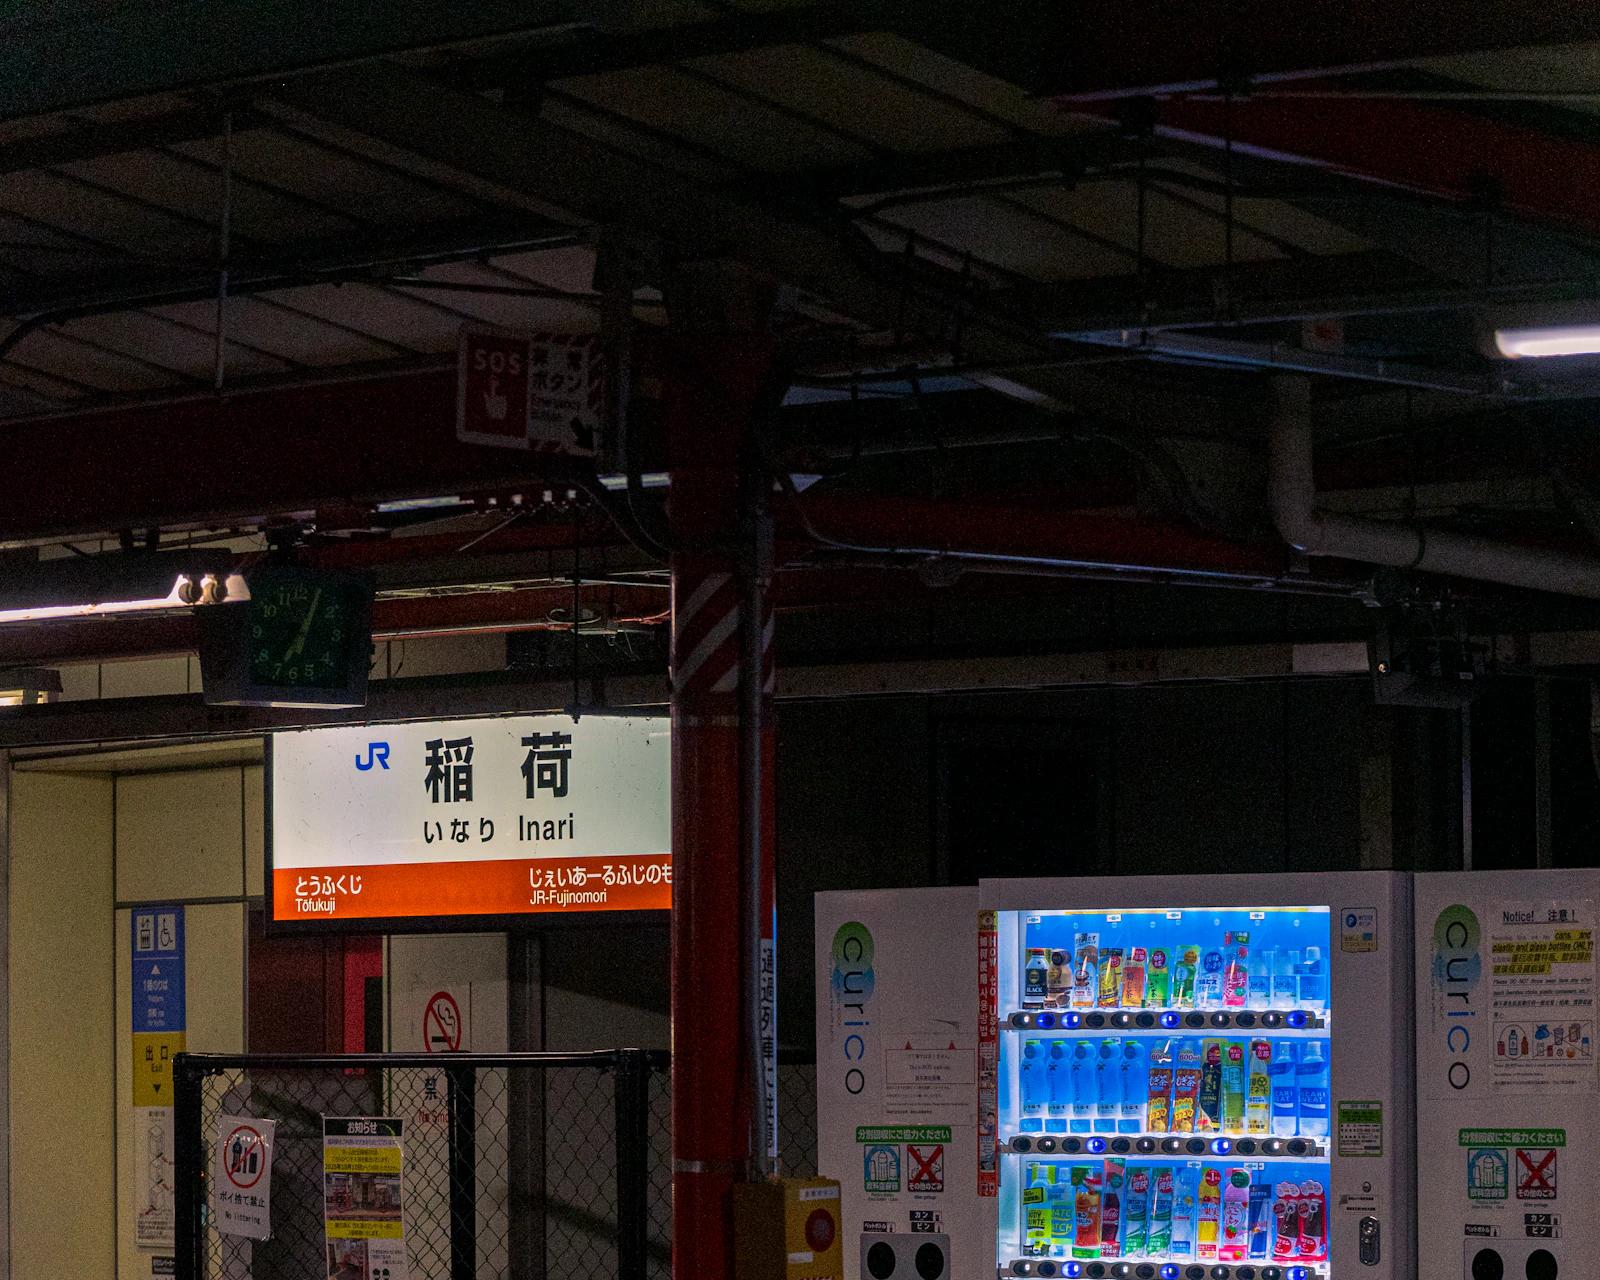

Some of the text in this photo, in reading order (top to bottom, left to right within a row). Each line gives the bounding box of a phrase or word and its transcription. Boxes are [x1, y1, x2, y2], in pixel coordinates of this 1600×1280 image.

[474, 349, 521, 375] SOS
[263, 605, 277, 618] 10
[289, 667, 298, 680] 6
[305, 664, 314, 677] 5
[355, 742, 390, 771] JR
[424, 731, 572, 804] 稲荷
[424, 813, 575, 844] いなり Inari
[295, 874, 363, 897] とうふくじ
[529, 888, 607, 908] JR-Fujinomori
[1503, 910, 1534, 923] Notice!
[1446, 921, 1476, 1090] curico
[843, 936, 870, 1095] curico
[146, 1045, 168, 1061] 出口
[347, 1121, 378, 1134] お知らせ
[220, 1191, 265, 1208] ポイ捨て禁止
[914, 1211, 929, 1219] カン
[1530, 1214, 1546, 1222] カン
